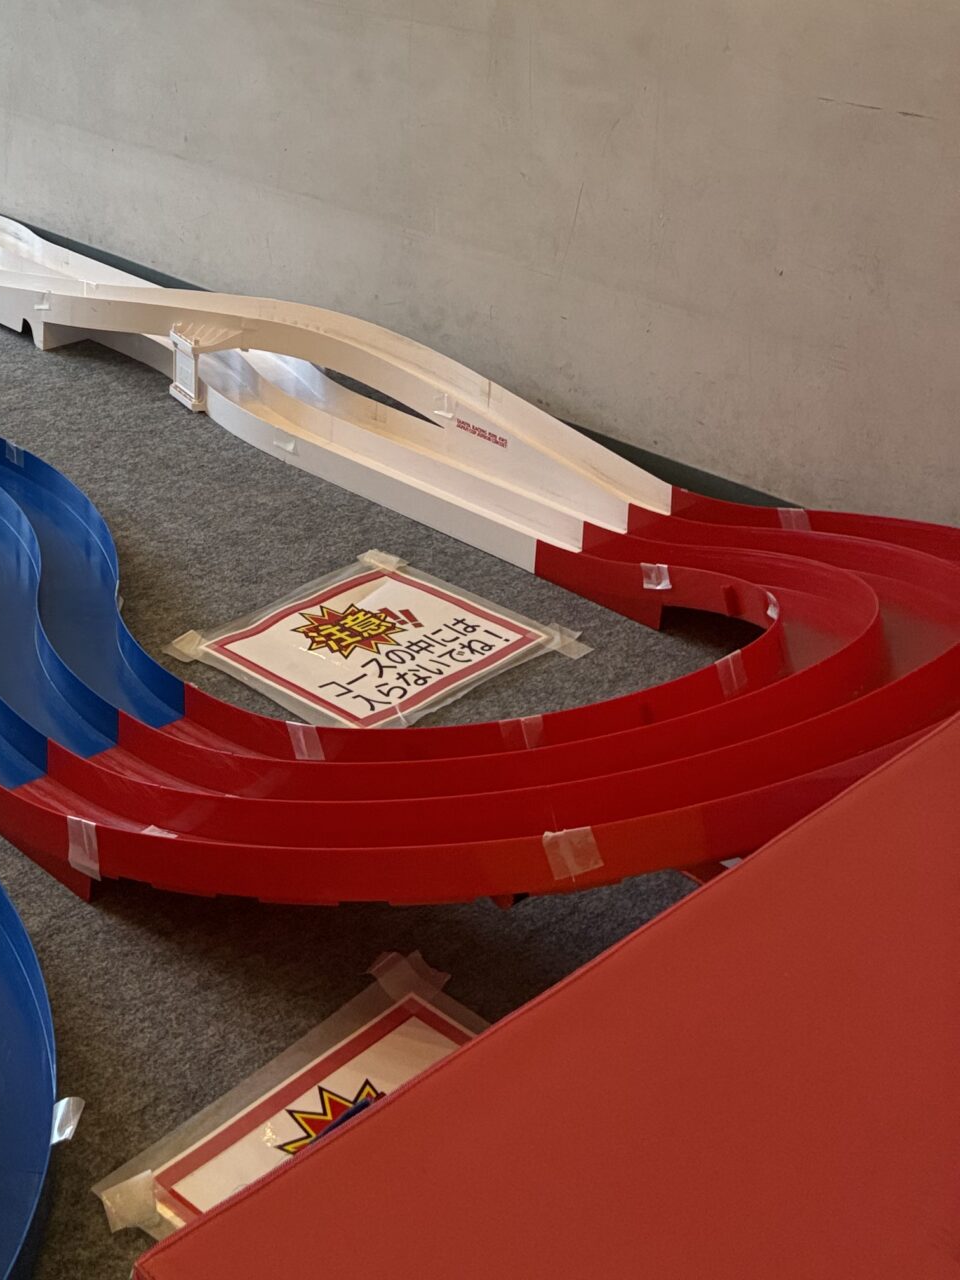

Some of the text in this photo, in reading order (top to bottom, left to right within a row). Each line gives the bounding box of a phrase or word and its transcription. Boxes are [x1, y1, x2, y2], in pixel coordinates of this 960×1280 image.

[318, 617, 482, 699] コースの中には
